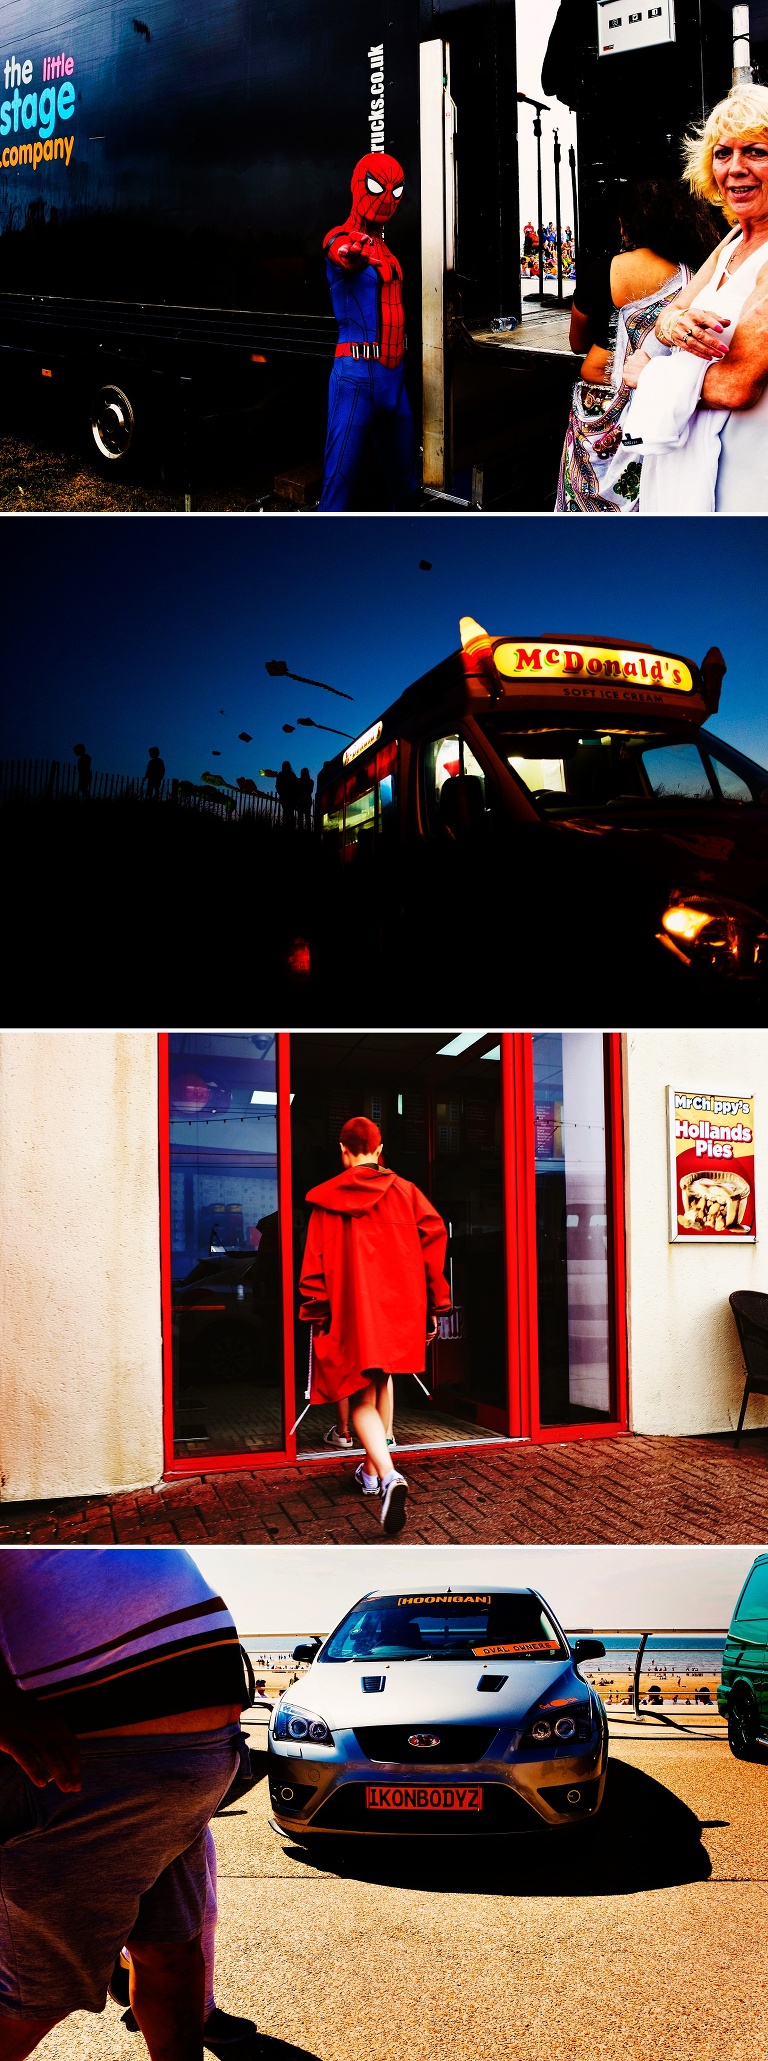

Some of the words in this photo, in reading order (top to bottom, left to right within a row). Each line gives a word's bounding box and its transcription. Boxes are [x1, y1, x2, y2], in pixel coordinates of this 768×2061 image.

[4, 56, 33, 89] the
[43, 52, 74, 82] little
[367, 43, 385, 154] rucks.co.uk
[0, 82, 75, 139] stage
[513, 648, 682, 685] McDonald's
[564, 687, 596, 698] SOFT
[600, 689, 621, 699] ICE
[624, 692, 664, 704] CREAM
[675, 1120, 752, 1143] Hollands
[695, 1140, 733, 1159] Pies
[513, 1643, 551, 1652] OWNERS
[369, 1788, 478, 1808] IKONBODYZ
